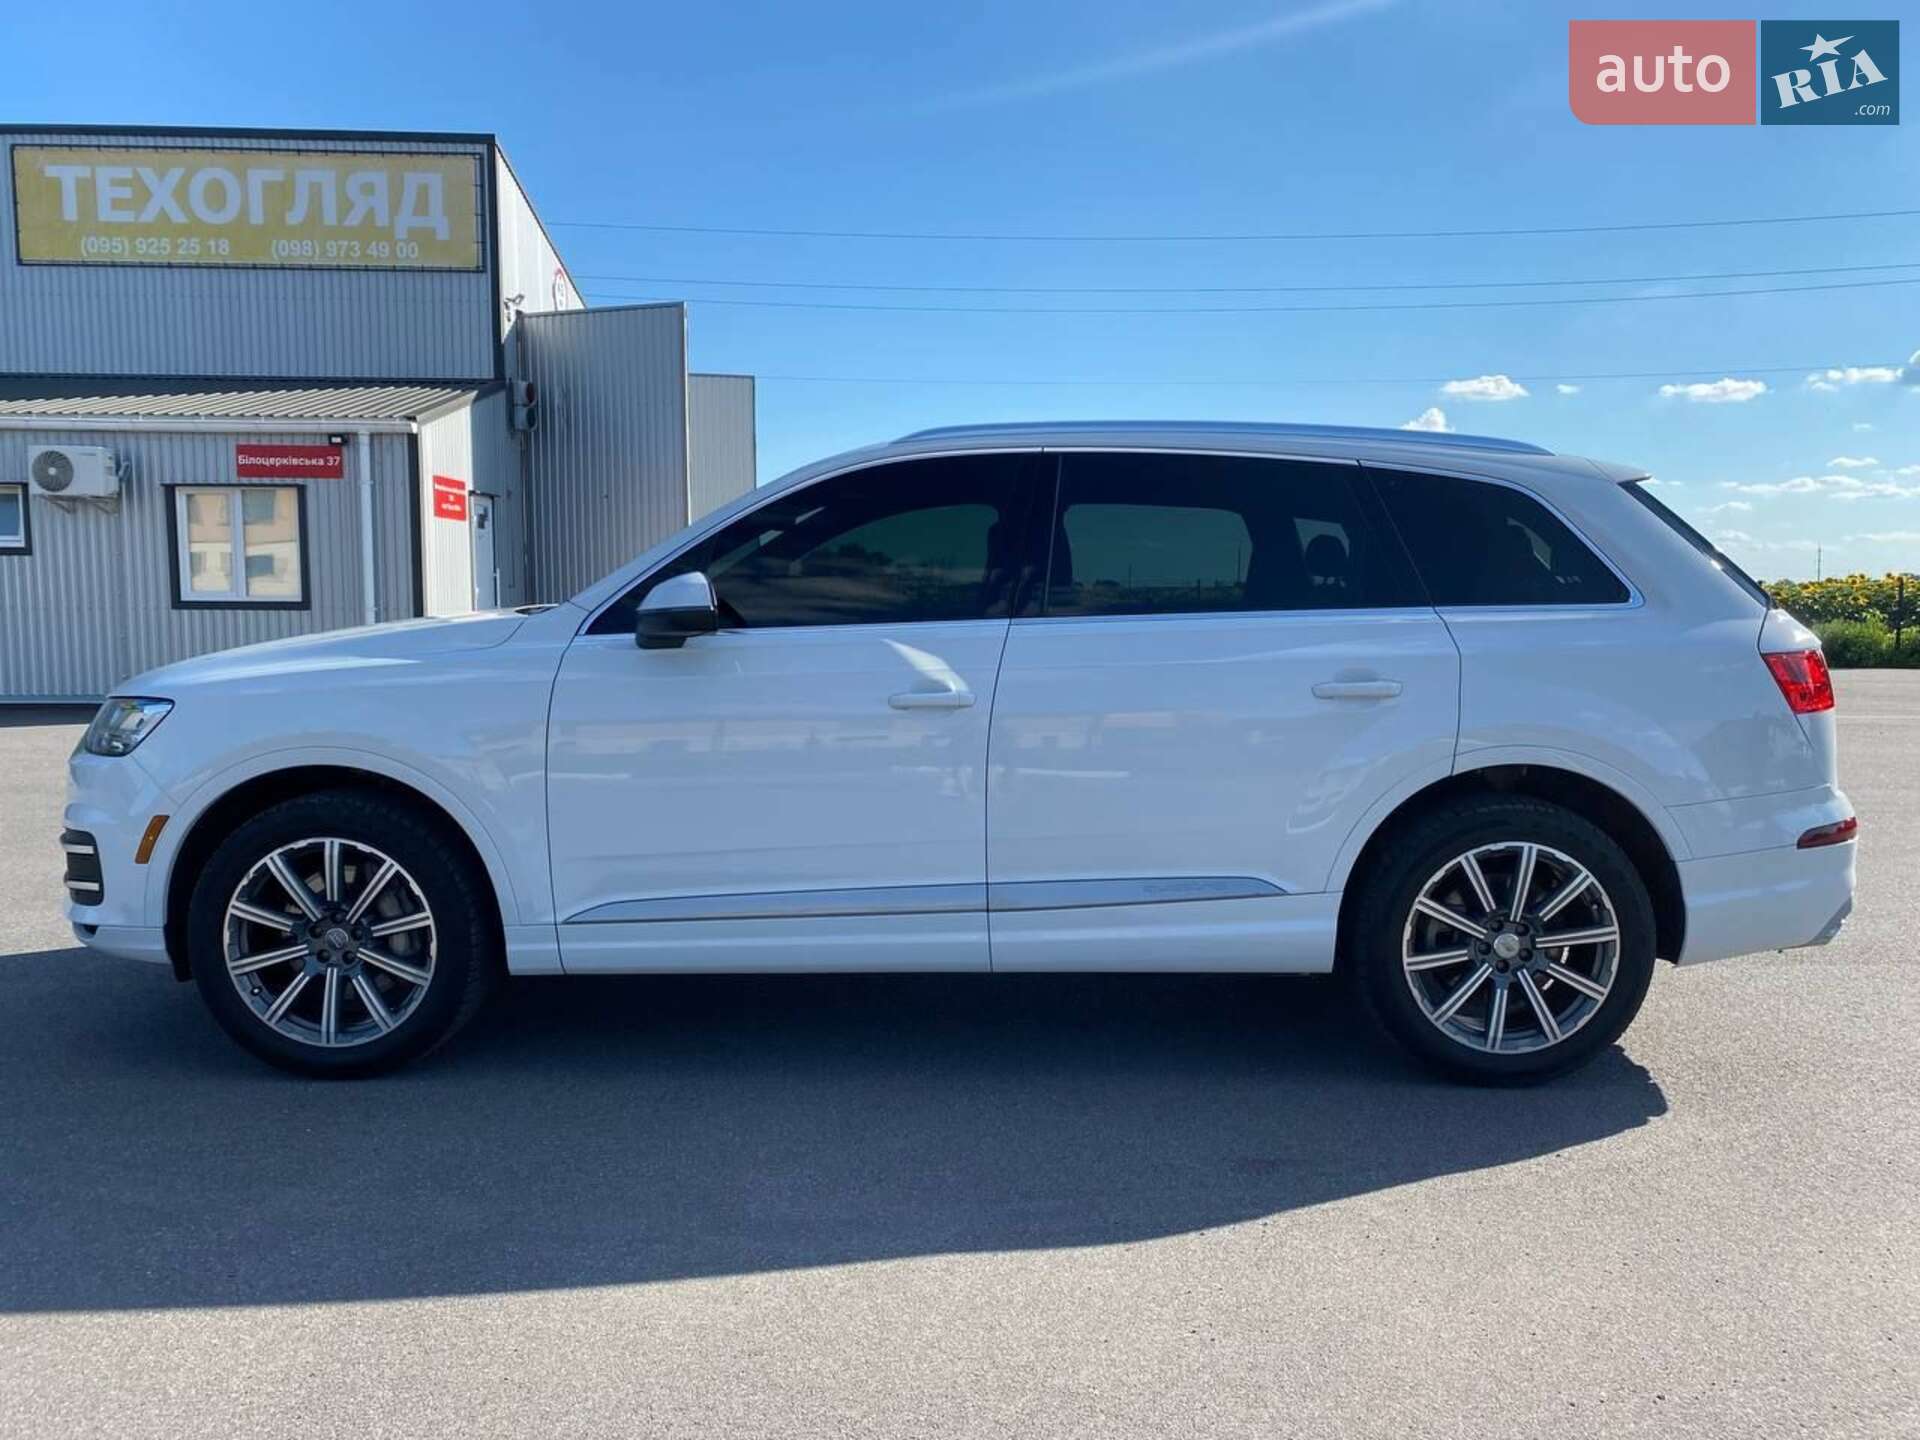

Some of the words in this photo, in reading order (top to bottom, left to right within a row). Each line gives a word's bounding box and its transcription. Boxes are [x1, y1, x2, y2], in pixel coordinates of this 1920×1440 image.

[45, 164, 450, 241] ТЕХОГЛЯД
[81, 235, 129, 257] (095)
[136, 236, 170, 255] 925
[177, 237, 200, 255] 25
[207, 238, 230, 255] 18
[271, 239, 319, 261] (098)
[326, 239, 361, 258] 973
[366, 240, 390, 258] 49
[396, 240, 418, 258] 00
[238, 454, 324, 467] Білоцерківська
[326, 455, 341, 466] 37
